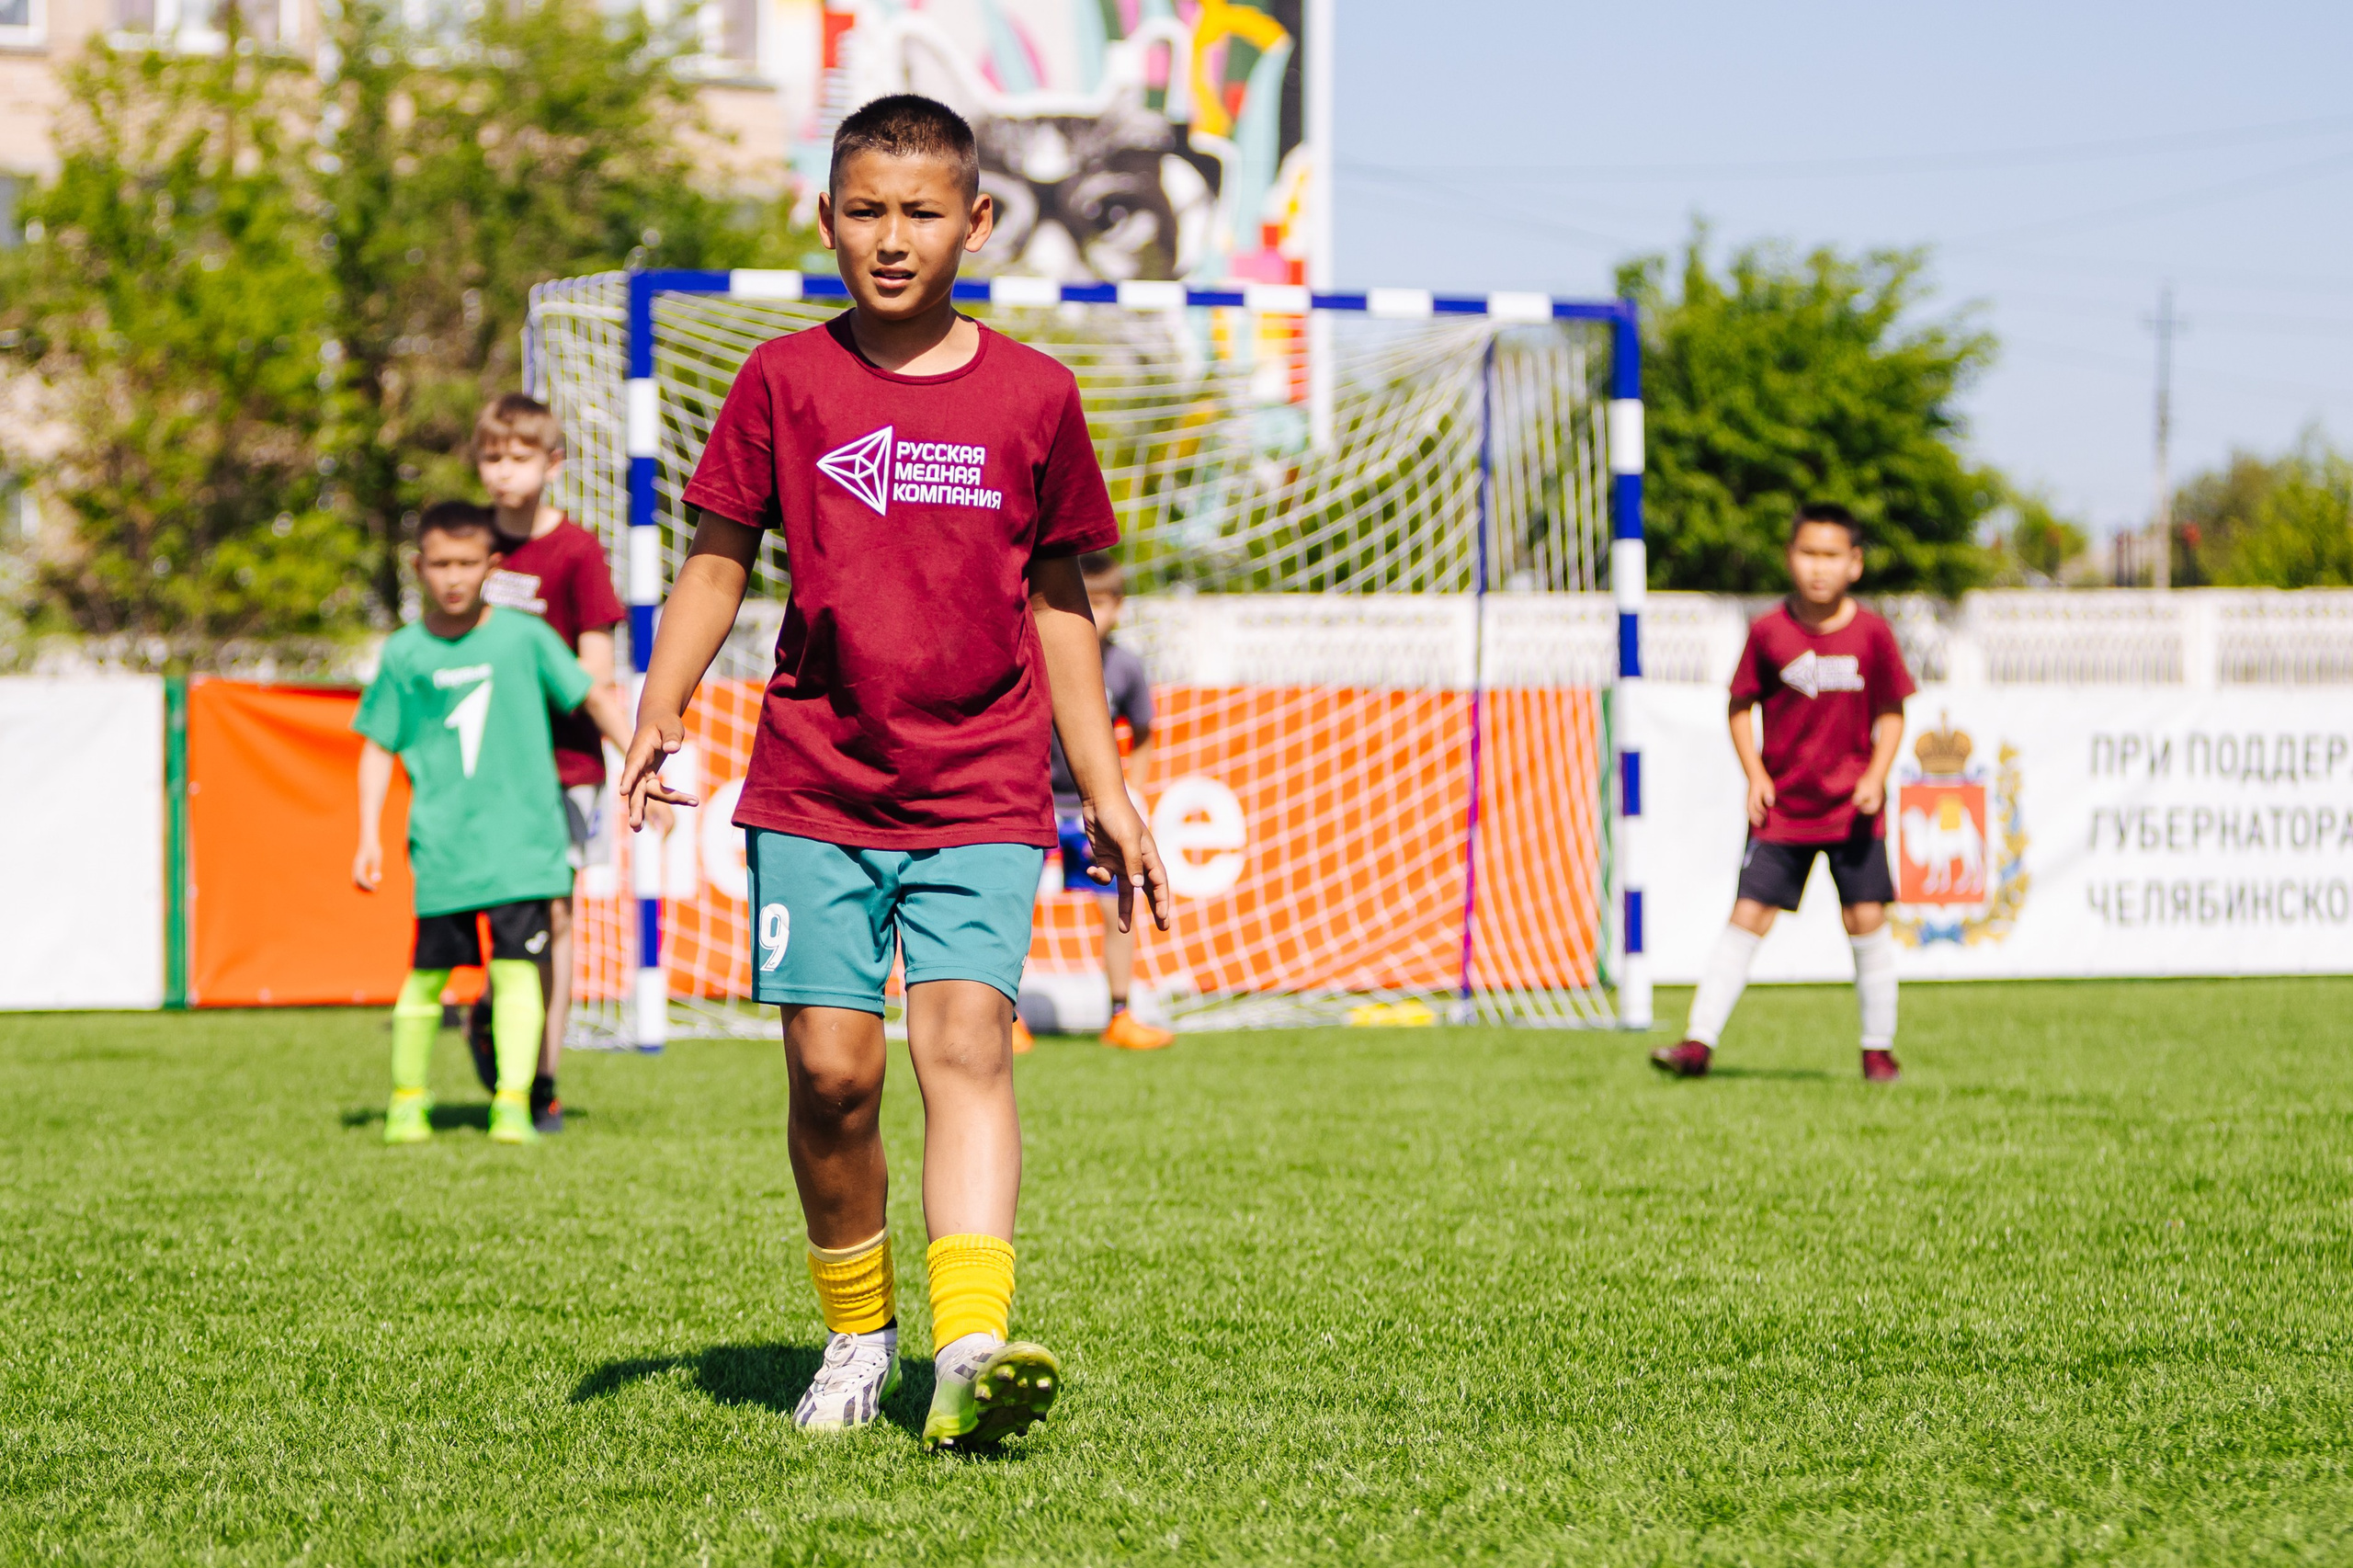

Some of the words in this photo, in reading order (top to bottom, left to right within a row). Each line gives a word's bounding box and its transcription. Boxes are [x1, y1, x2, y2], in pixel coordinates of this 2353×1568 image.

[894, 461, 981, 485] МЕДНАЯ
[896, 441, 985, 465] РУССКАЯ
[892, 483, 1002, 509] КОМПАНИЯ
[2090, 733, 2172, 777] ПРИ
[2186, 733, 2353, 786] ПОДДЕР
[2087, 805, 2353, 851] ГУБЕРНАТОРА
[2086, 878, 2350, 926] ЧЕЛЯБИНСКО
[759, 903, 790, 971] 9
